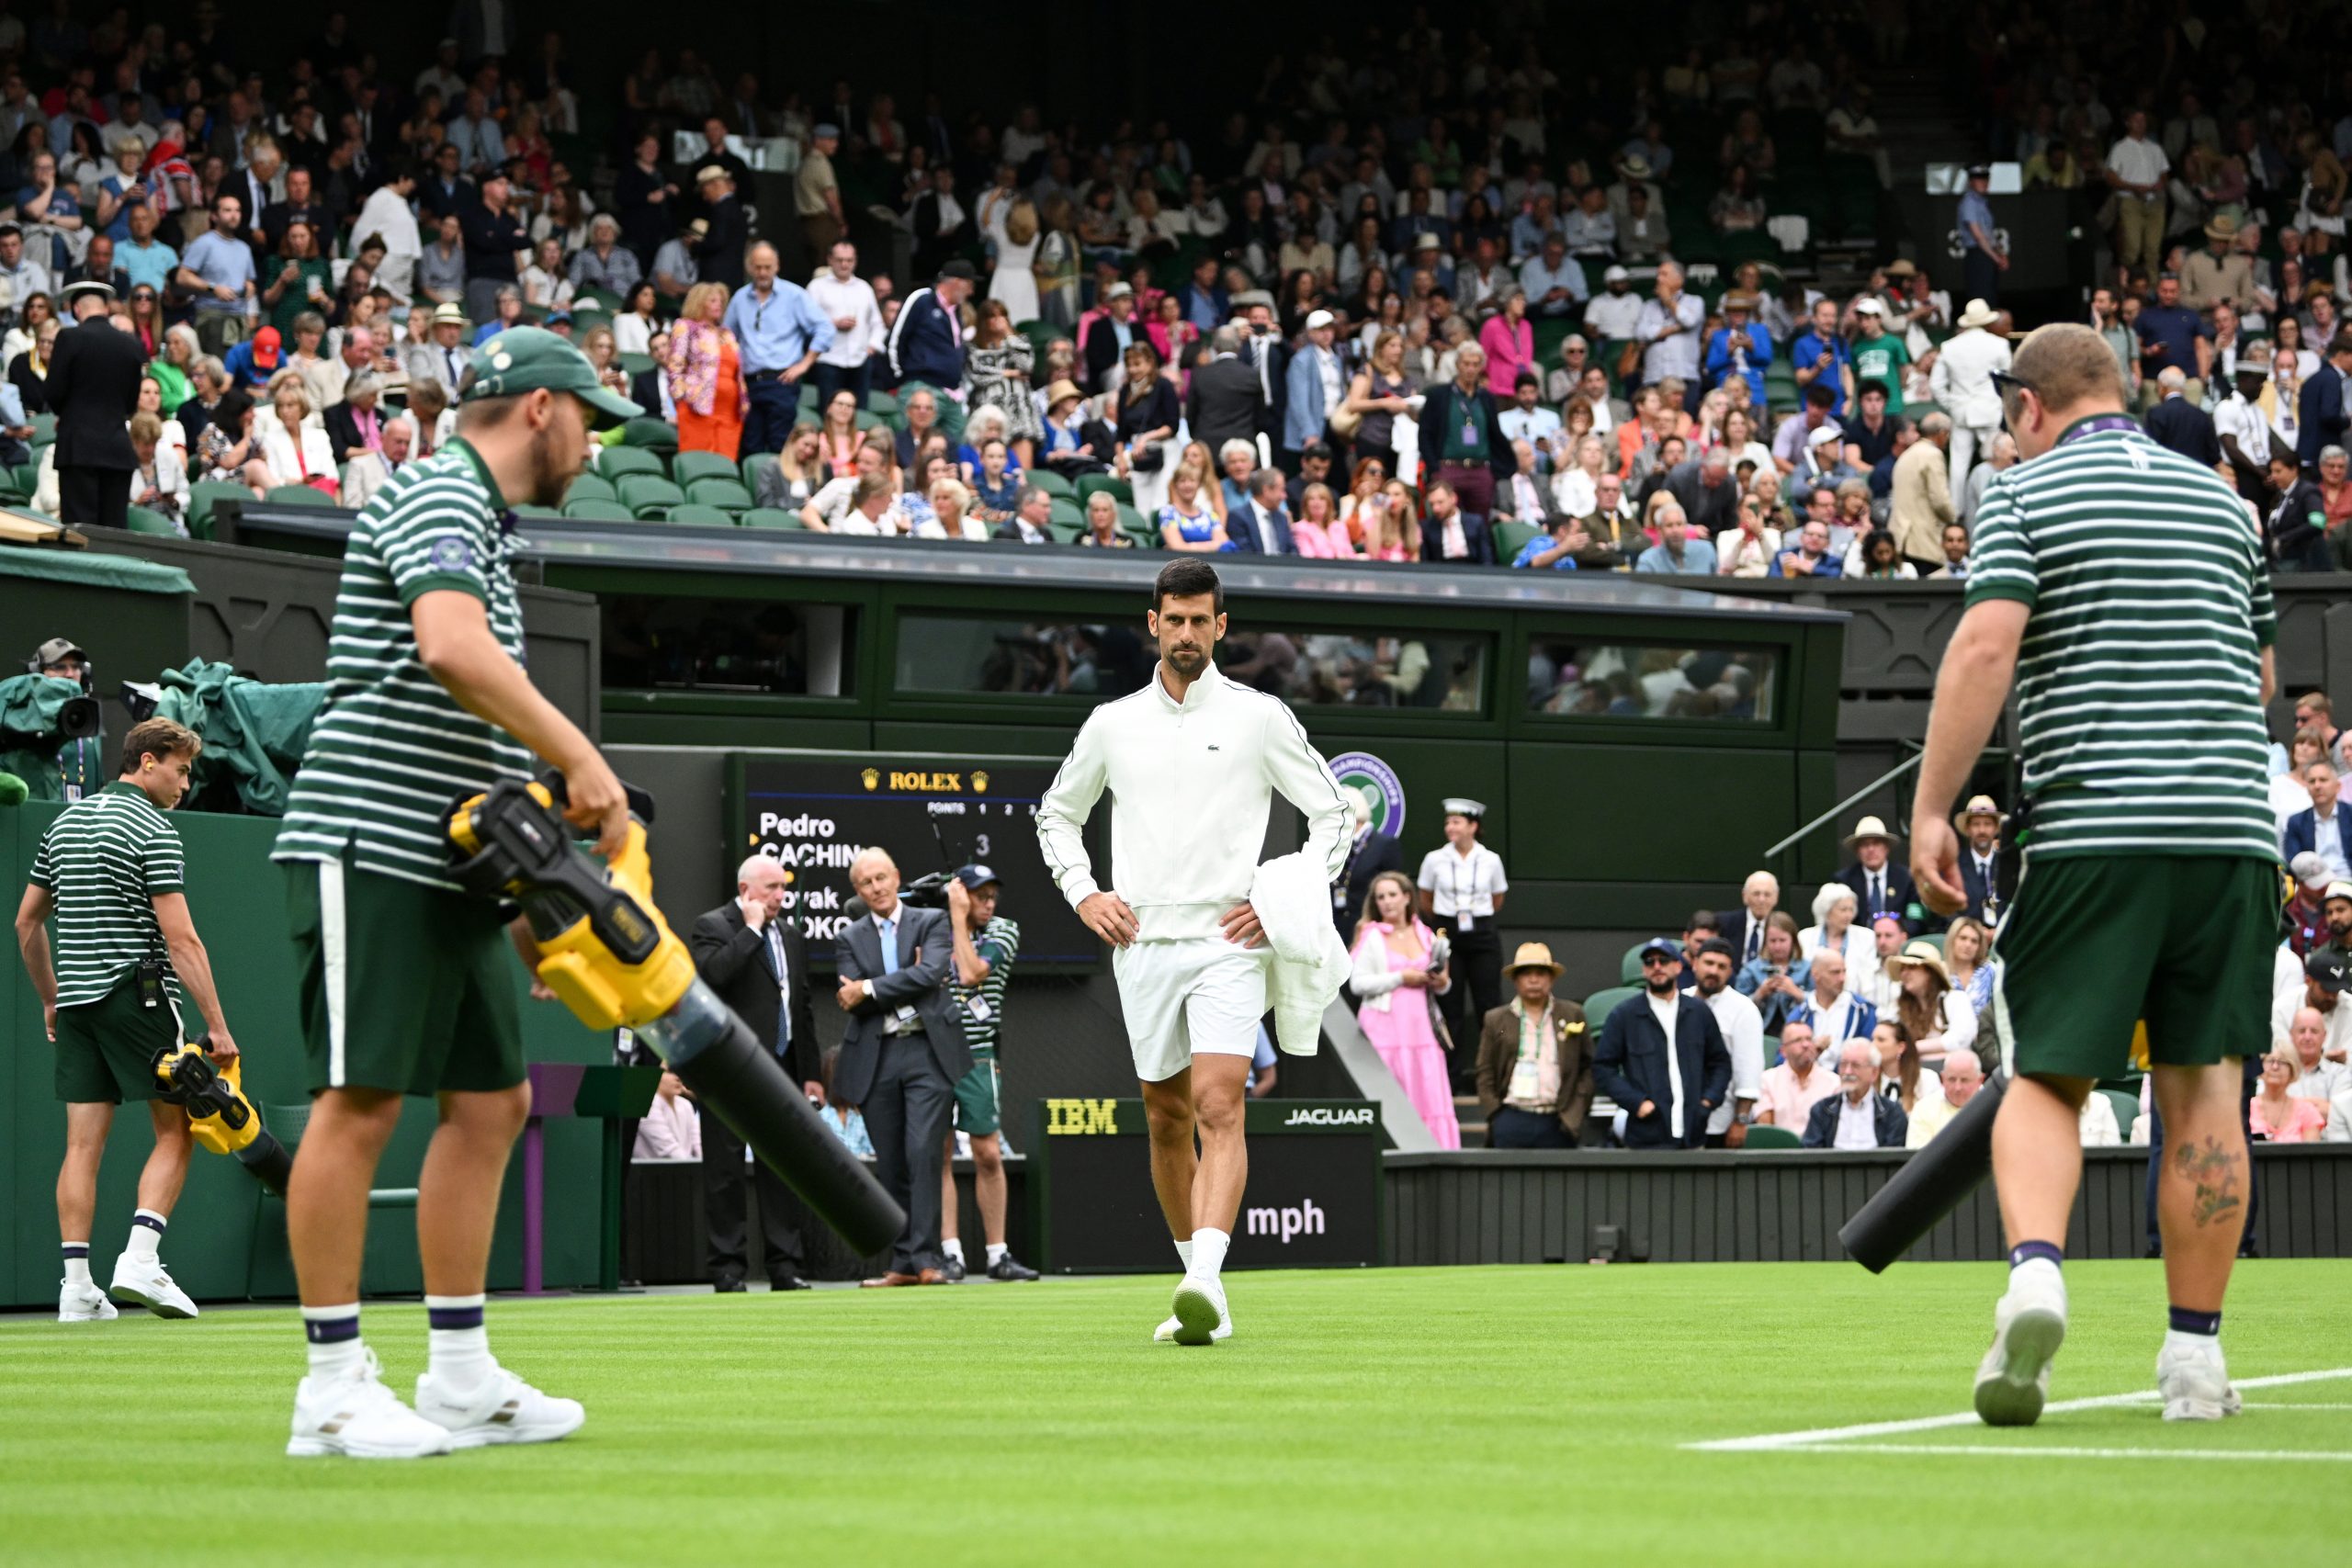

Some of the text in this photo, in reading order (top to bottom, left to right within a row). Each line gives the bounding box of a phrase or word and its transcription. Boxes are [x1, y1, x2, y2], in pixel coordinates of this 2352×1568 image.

[889, 772, 963, 792] ROLEX
[1331, 757, 1400, 807] HAMPIONSHIPS
[927, 802, 966, 815] POINTS
[978, 803, 987, 815] 1
[1004, 804, 1013, 816] 2
[761, 812, 835, 838] Pedro
[760, 842, 861, 867] CACHIN
[976, 833, 990, 856] 3
[1046, 1099, 1117, 1134] IBM
[1284, 1108, 1374, 1125] JAGUAR
[1247, 1198, 1325, 1244] mph
